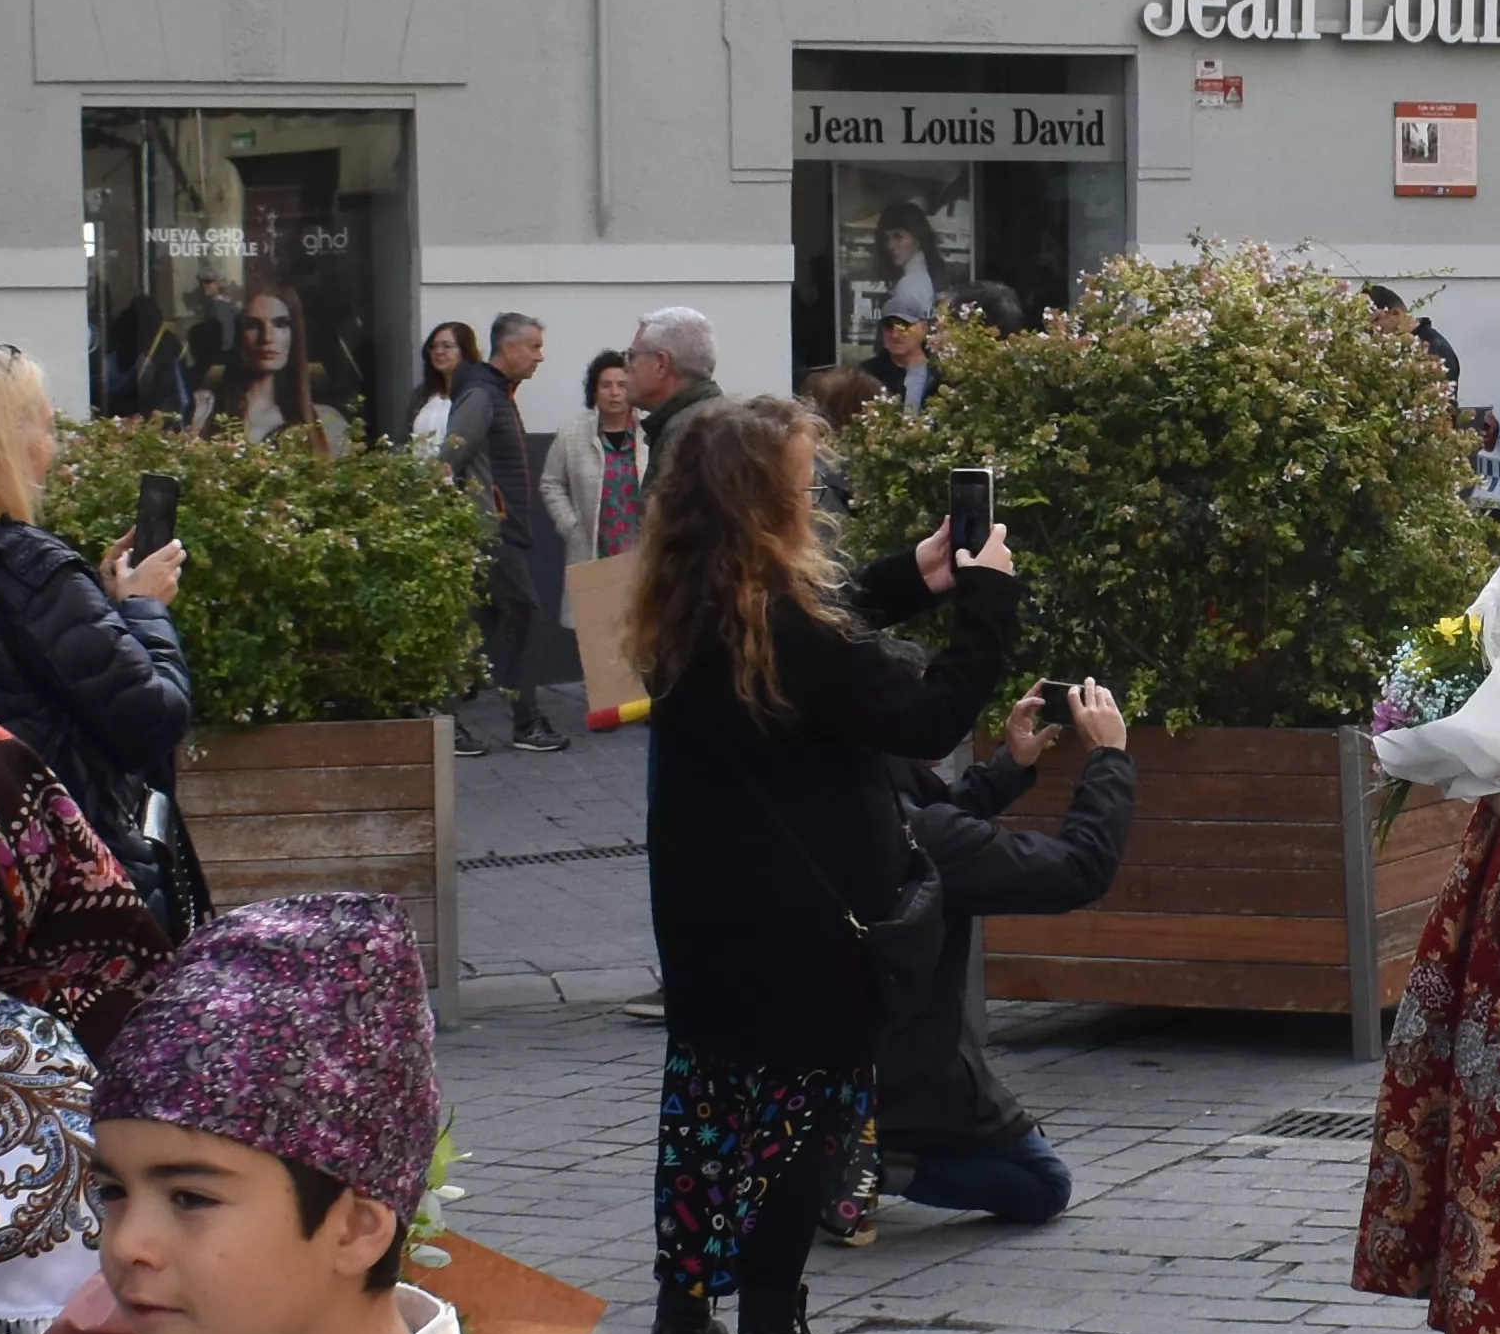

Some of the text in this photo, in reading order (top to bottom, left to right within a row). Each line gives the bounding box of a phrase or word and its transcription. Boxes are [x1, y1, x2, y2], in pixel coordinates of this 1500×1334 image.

[804, 105, 1105, 147] Jean Louis David
[144, 228, 244, 243] NUEVA GHD
[303, 227, 348, 255] ghd
[169, 242, 259, 257] DUET STYLE
